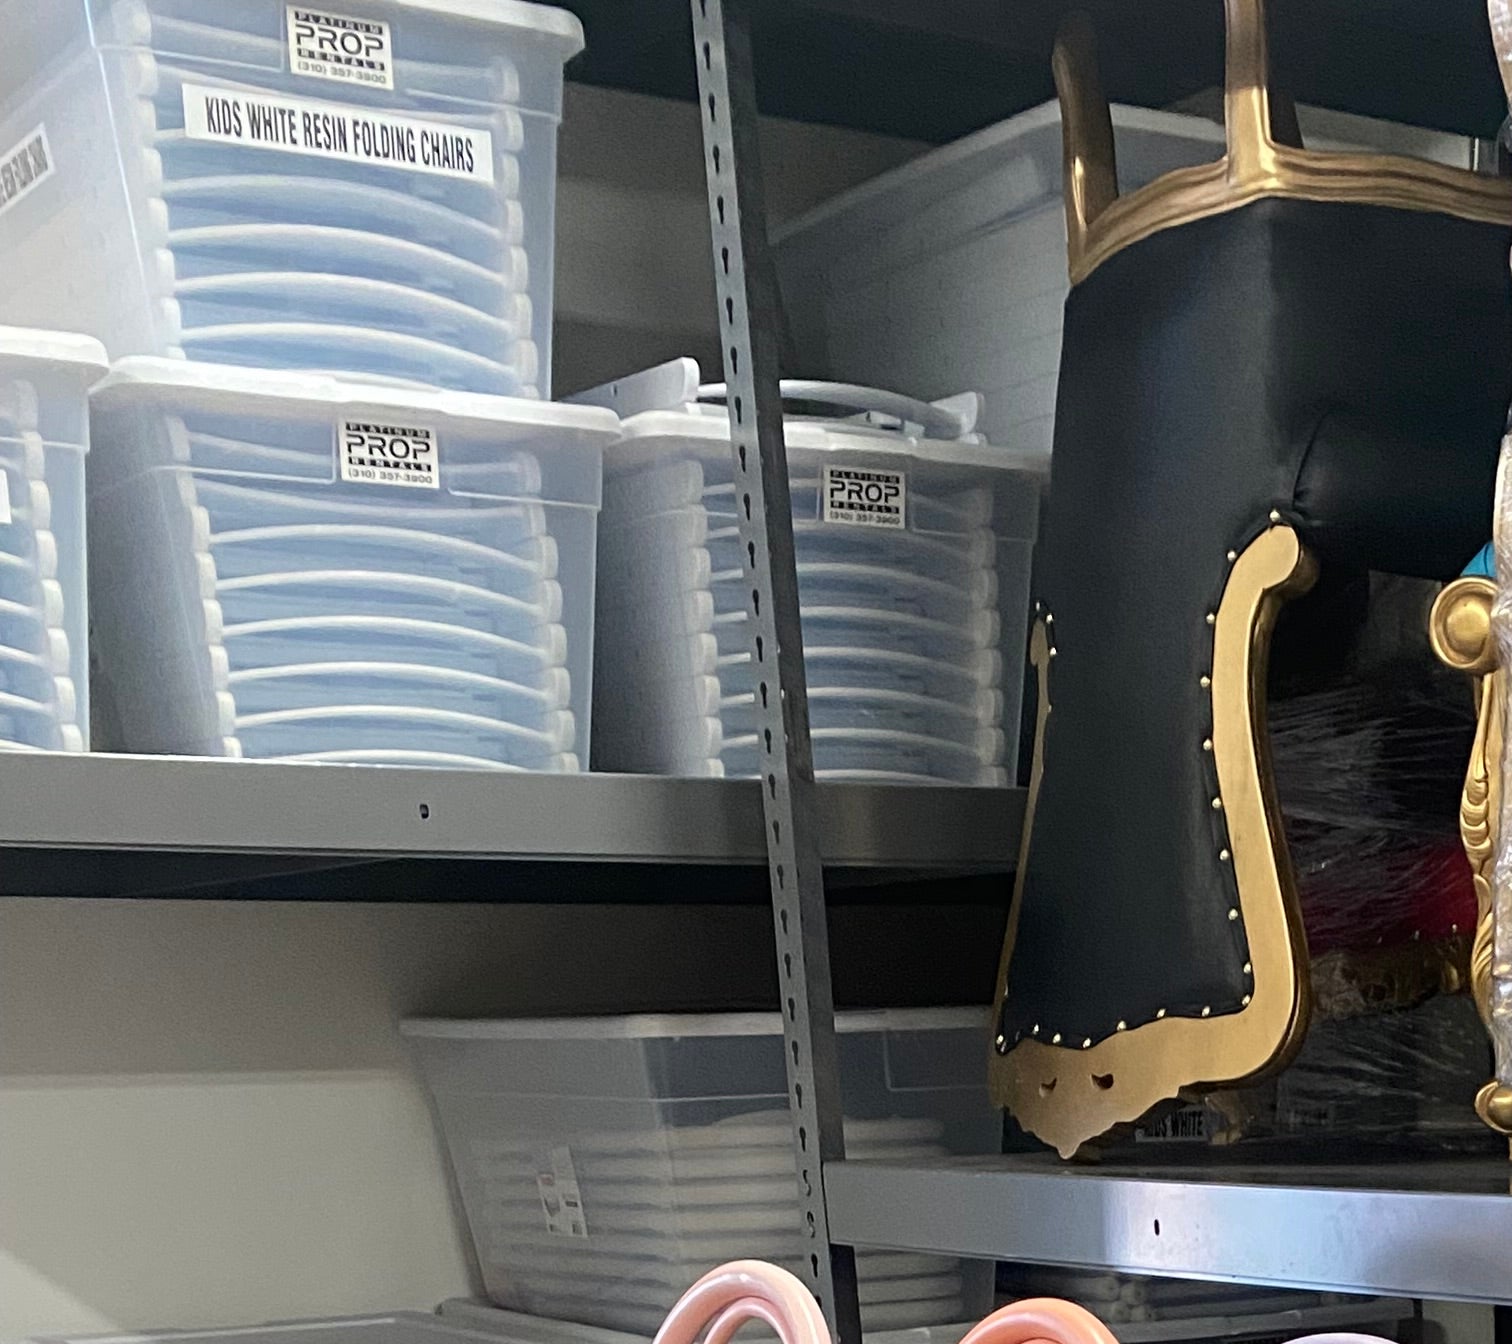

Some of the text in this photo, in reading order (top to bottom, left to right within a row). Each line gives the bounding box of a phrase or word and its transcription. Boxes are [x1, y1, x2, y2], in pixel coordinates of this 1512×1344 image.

[295, 11, 382, 35] PLATINUM
[295, 23, 384, 57] PROP
[297, 47, 384, 70] RENTALS
[205, 96, 474, 173] KIDS WHITE RESIN FOLDING CHAIRS
[346, 422, 430, 439] PLATINUM
[346, 433, 430, 460] PROP
[348, 456, 432, 472] RENTALS
[830, 479, 900, 504] PROP
[1171, 1110, 1203, 1137] WHITE
